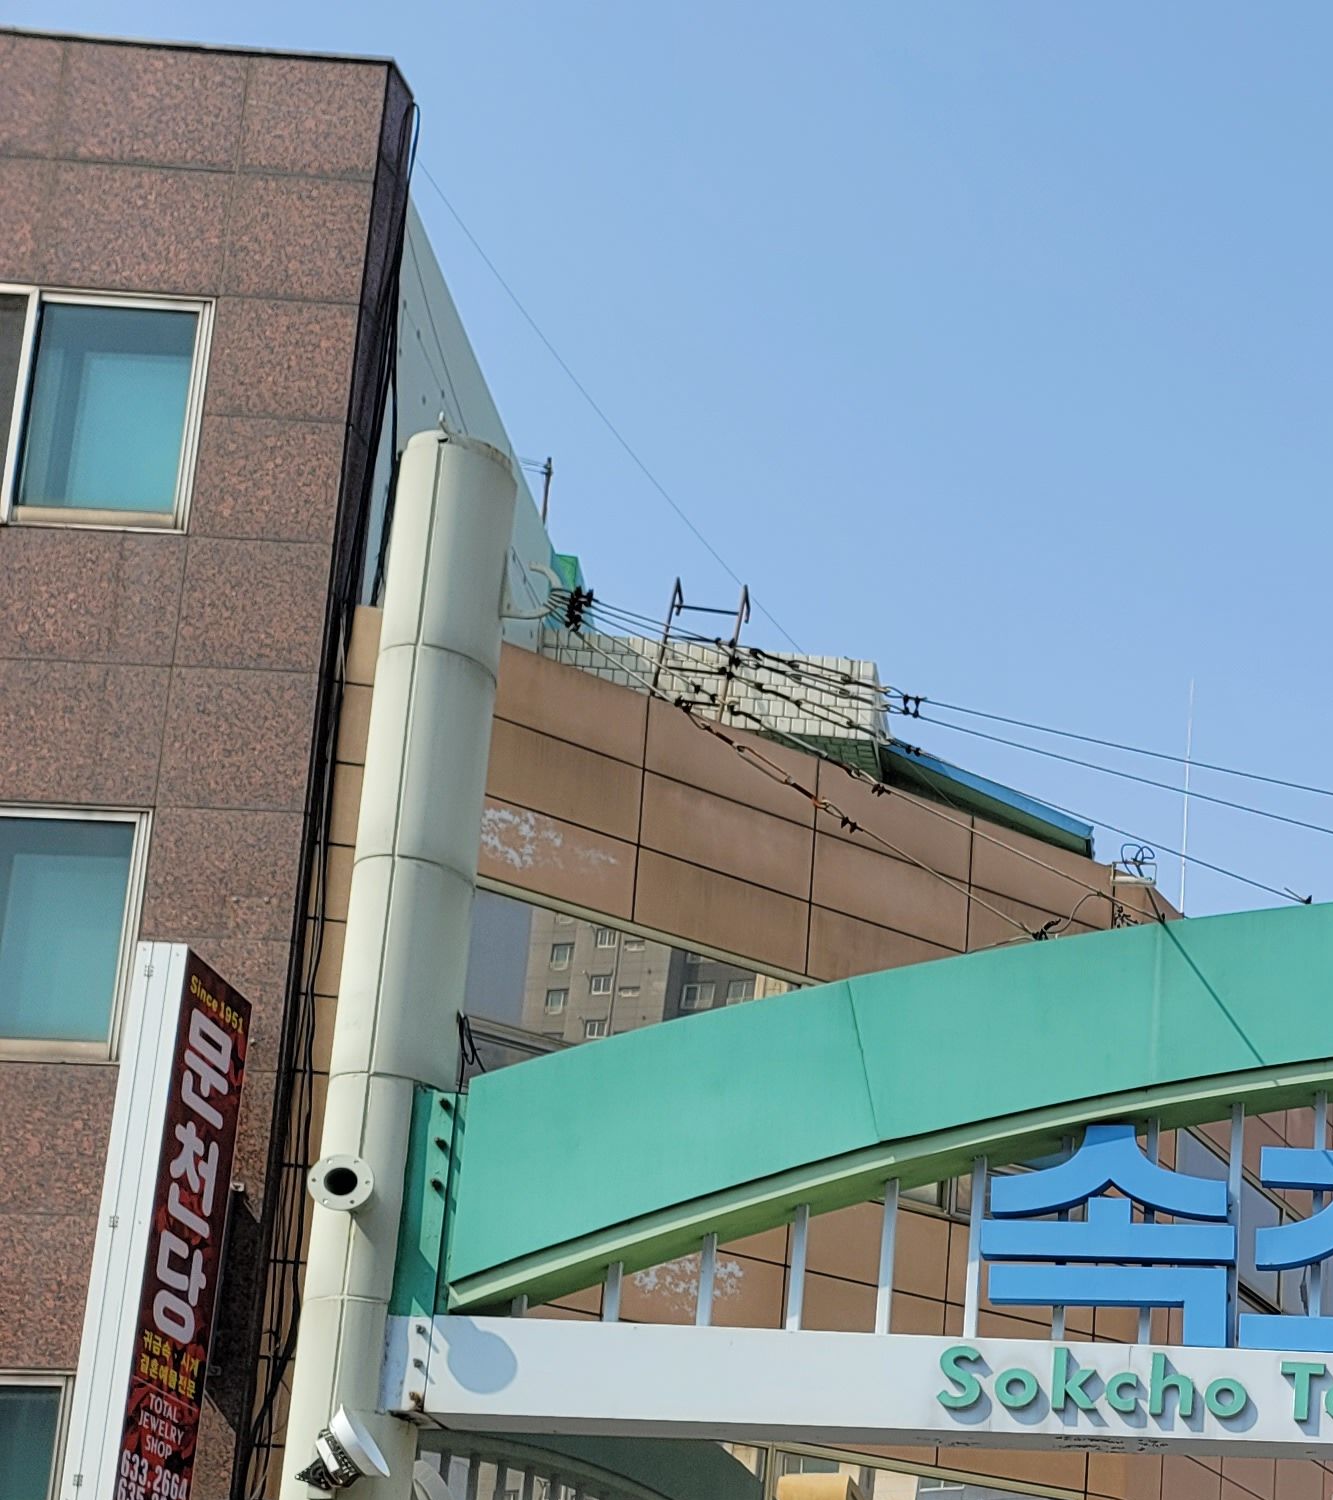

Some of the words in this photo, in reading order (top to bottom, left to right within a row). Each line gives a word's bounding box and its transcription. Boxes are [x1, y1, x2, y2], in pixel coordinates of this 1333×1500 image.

[190, 974, 218, 1011] Since
[220, 1001, 244, 1034] 1951
[936, 1344, 1248, 1420] Sokcho
[149, 1392, 179, 1424] TOTAL
[138, 1410, 185, 1446] JEWELRY
[145, 1435, 172, 1461] SHOP
